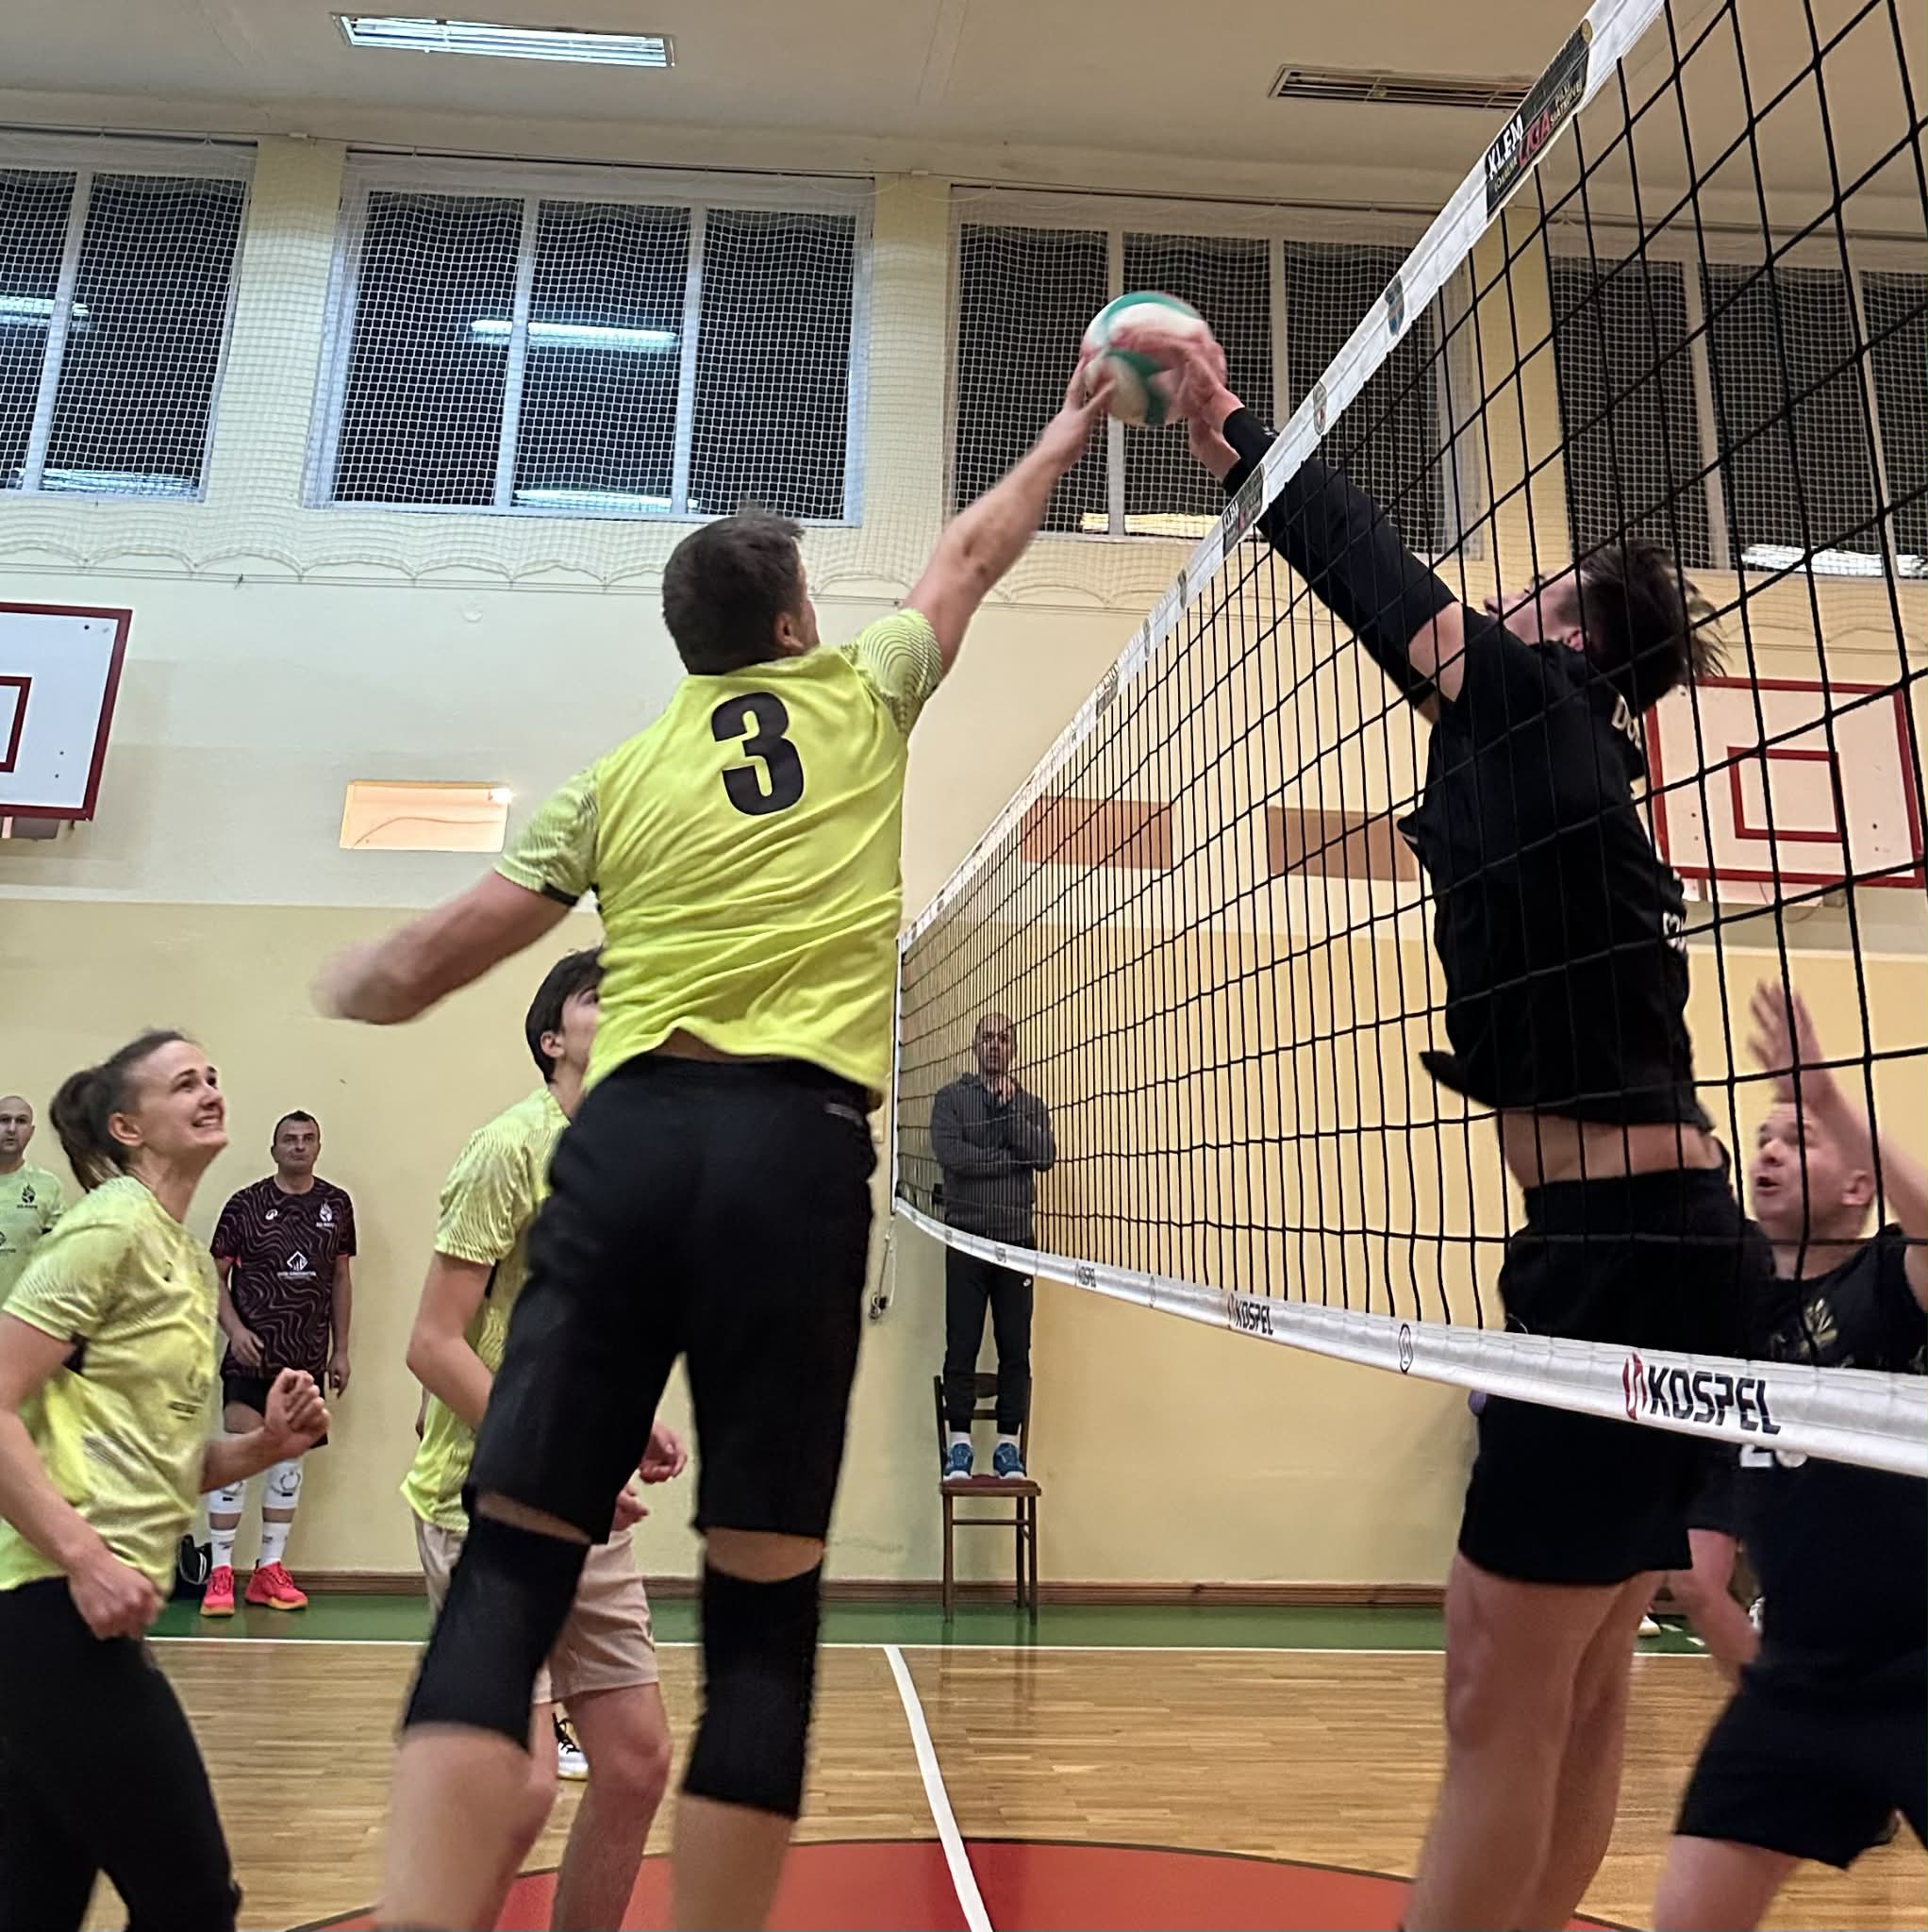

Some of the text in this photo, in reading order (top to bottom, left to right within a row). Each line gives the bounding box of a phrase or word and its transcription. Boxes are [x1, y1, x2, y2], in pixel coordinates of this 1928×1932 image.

[1488, 113, 1524, 180] KLEM
[1518, 106, 1552, 167] LIGA
[710, 691, 806, 816] 3
[1236, 1299, 1274, 1336] KOSPEL
[1648, 1364, 1782, 1435] KOSPEL
